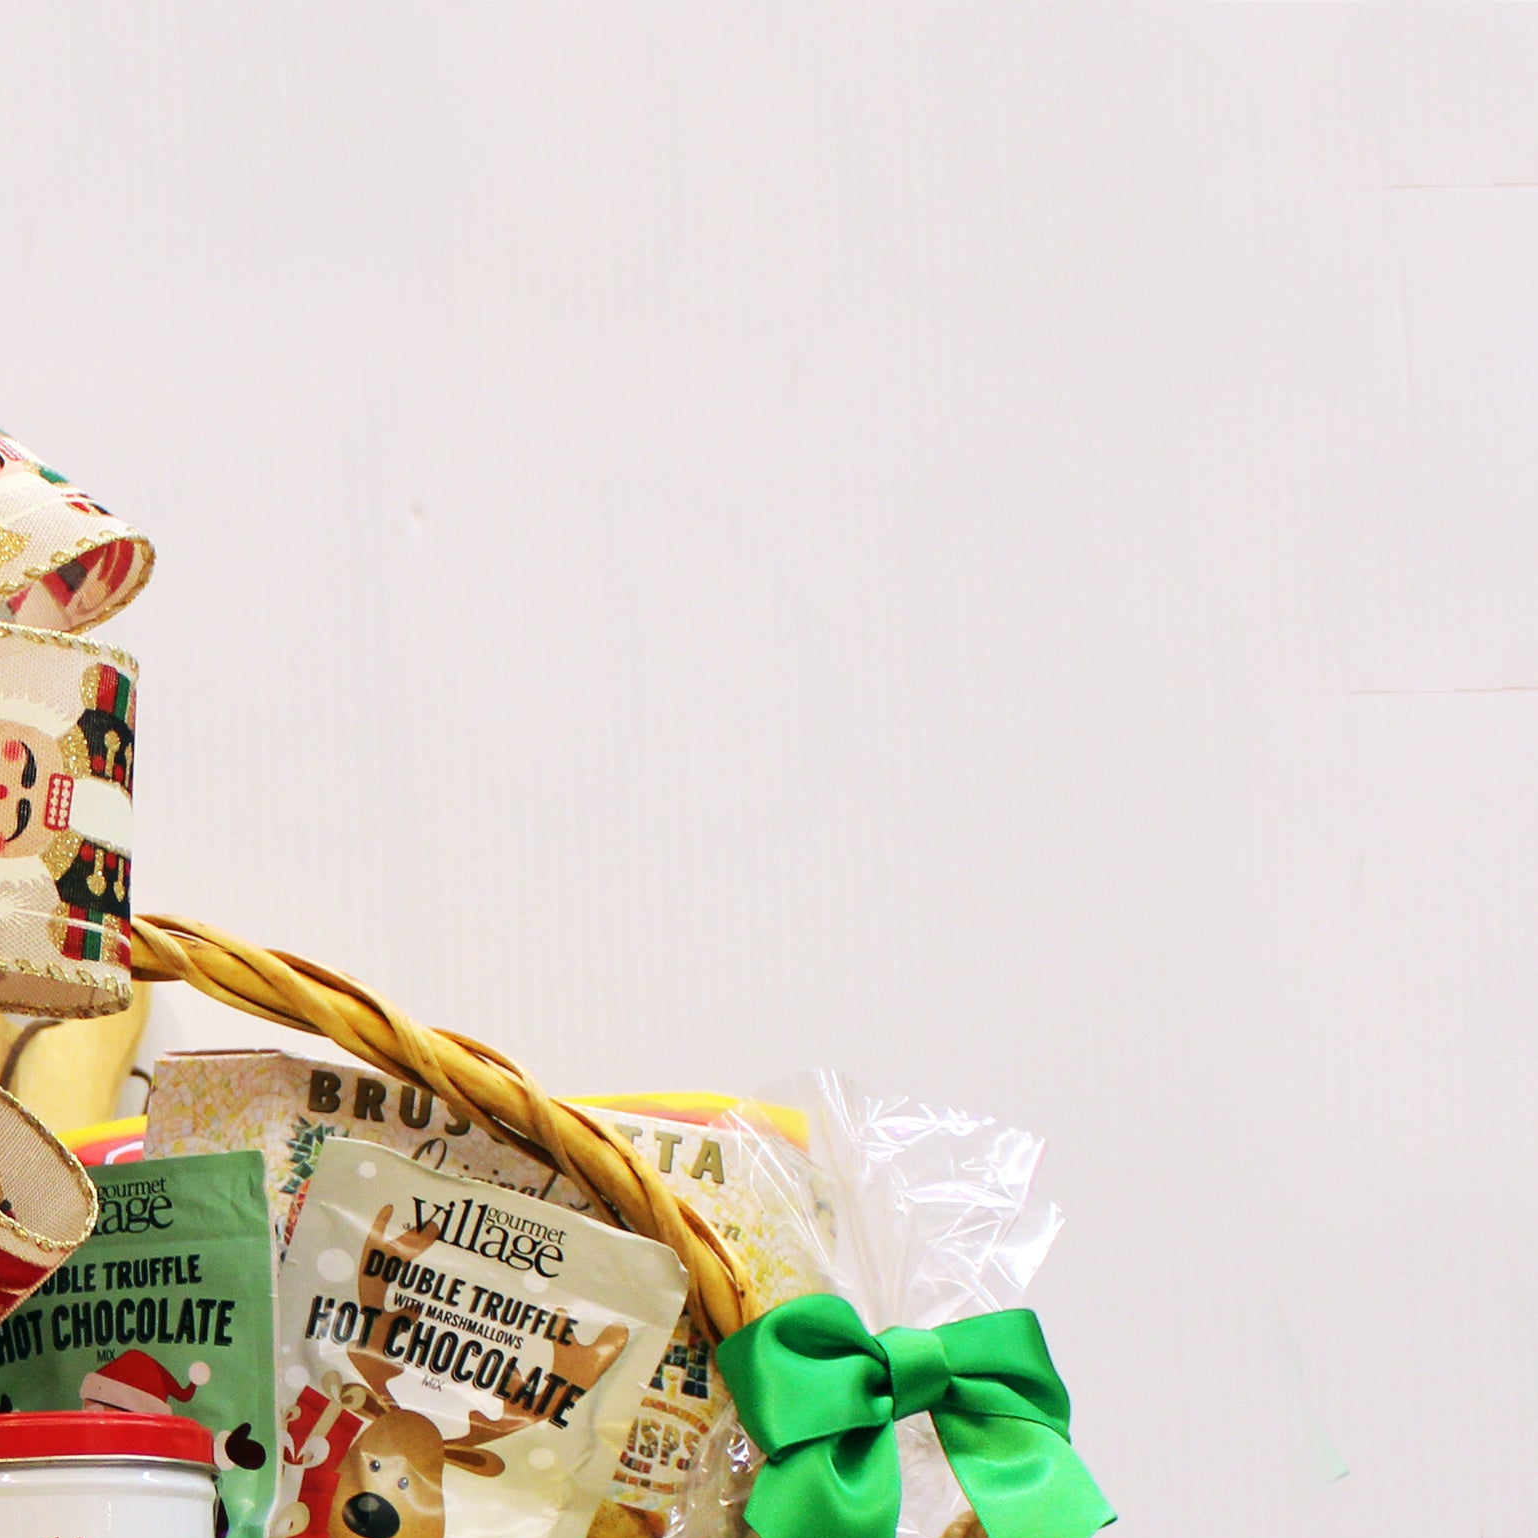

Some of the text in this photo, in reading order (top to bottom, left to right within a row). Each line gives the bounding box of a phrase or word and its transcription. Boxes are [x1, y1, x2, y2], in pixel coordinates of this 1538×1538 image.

[413, 1196, 564, 1279] village
[484, 1206, 568, 1247] gourmet
[102, 1254, 203, 1291] TRUFFLE
[364, 1248, 579, 1347] DOUBLE TRUFFLE
[51, 1297, 237, 1351] CHOCOLATE
[393, 1292, 524, 1351] WITH MARSHMALLOWS
[97, 1350, 116, 1363] MIX
[305, 1296, 587, 1429] HOT CHOCOLATE
[421, 1374, 445, 1393] MIX
